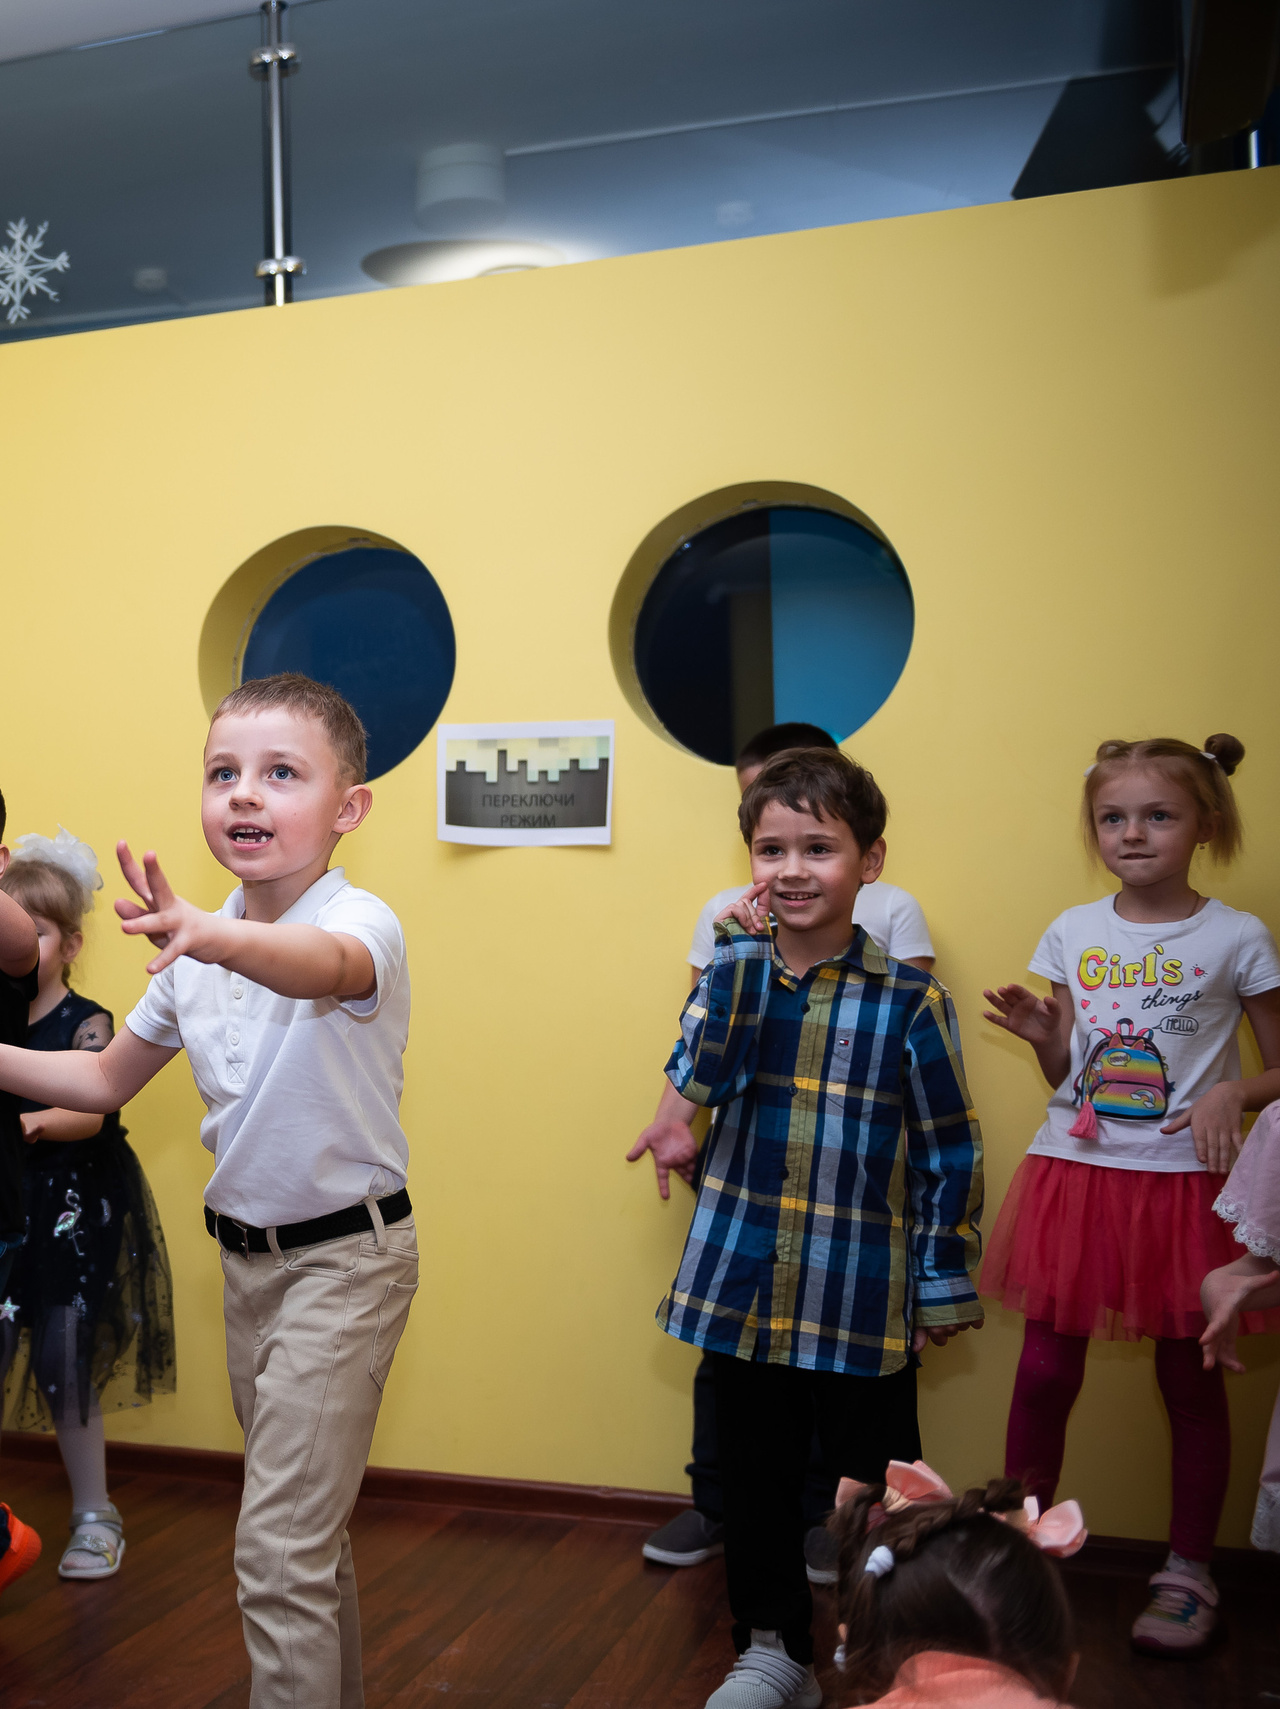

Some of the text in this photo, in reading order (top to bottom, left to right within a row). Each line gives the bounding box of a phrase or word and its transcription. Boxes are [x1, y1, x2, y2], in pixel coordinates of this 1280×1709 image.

[481, 793, 575, 808] ПЕРЕКЛЮЧИ
[500, 814, 556, 828] РЕЖИМ
[1141, 987, 1204, 1012] things
